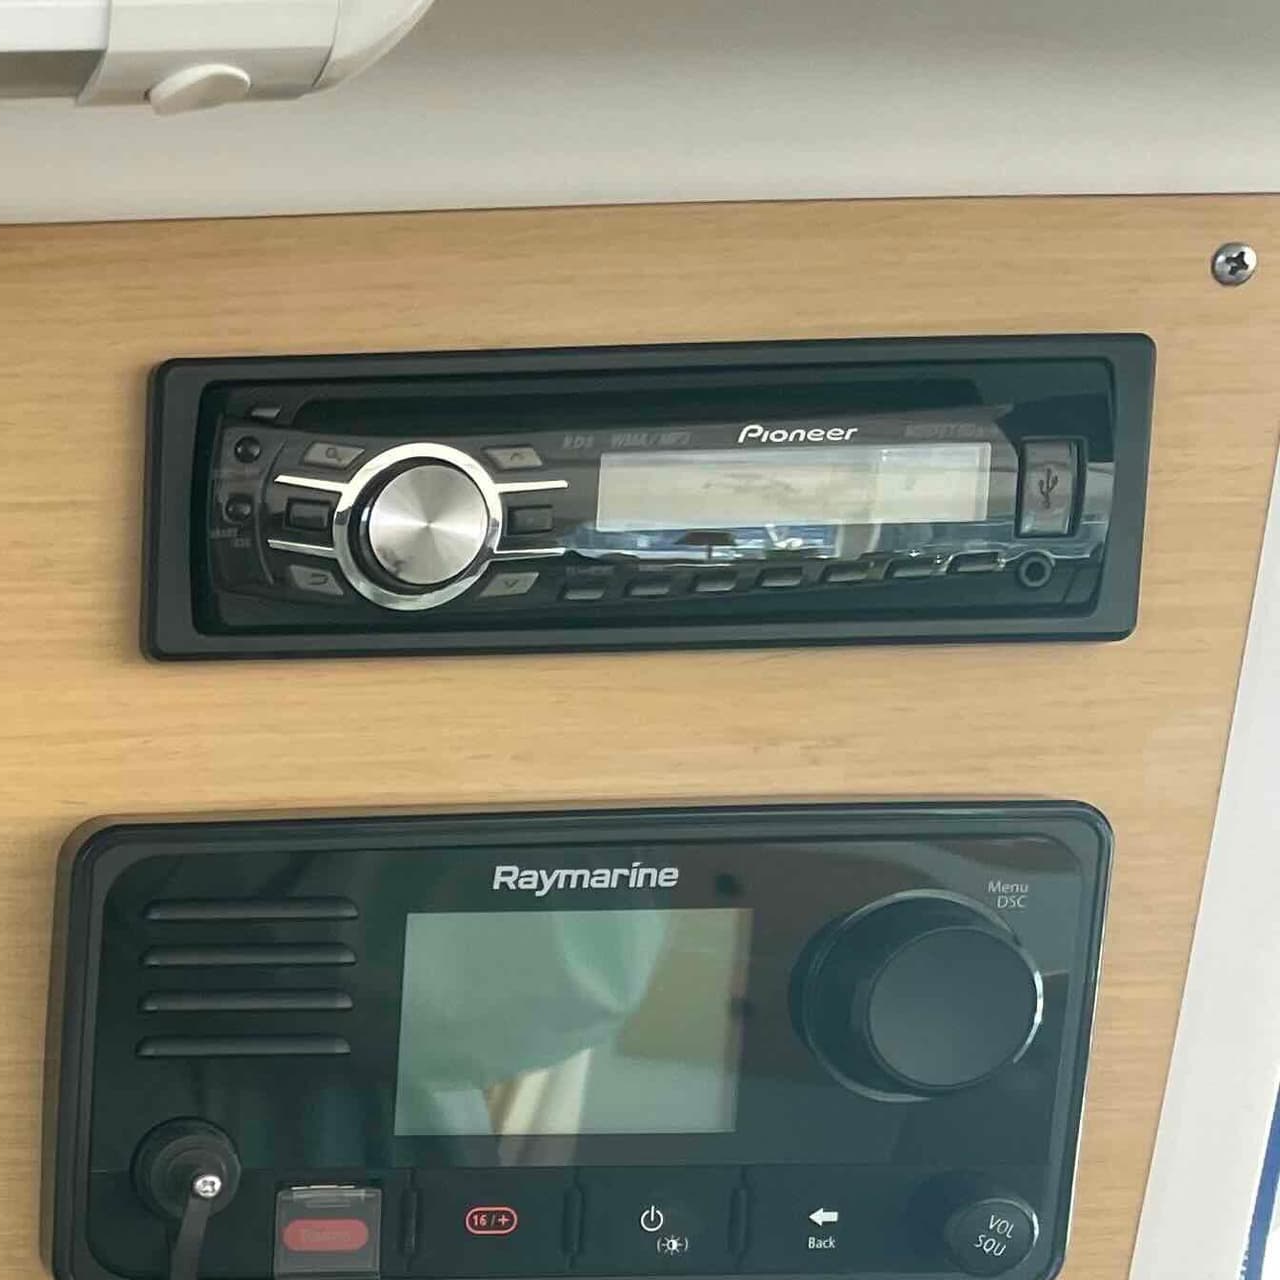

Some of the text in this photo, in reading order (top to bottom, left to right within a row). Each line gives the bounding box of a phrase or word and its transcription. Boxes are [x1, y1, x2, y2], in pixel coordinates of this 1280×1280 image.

[738, 424, 859, 443] Pioneer
[493, 862, 679, 897] Raymarine
[988, 880, 1028, 893] Menu
[997, 895, 1026, 909] DSC
[989, 1214, 1014, 1238] VOL
[808, 1237, 836, 1250] Back
